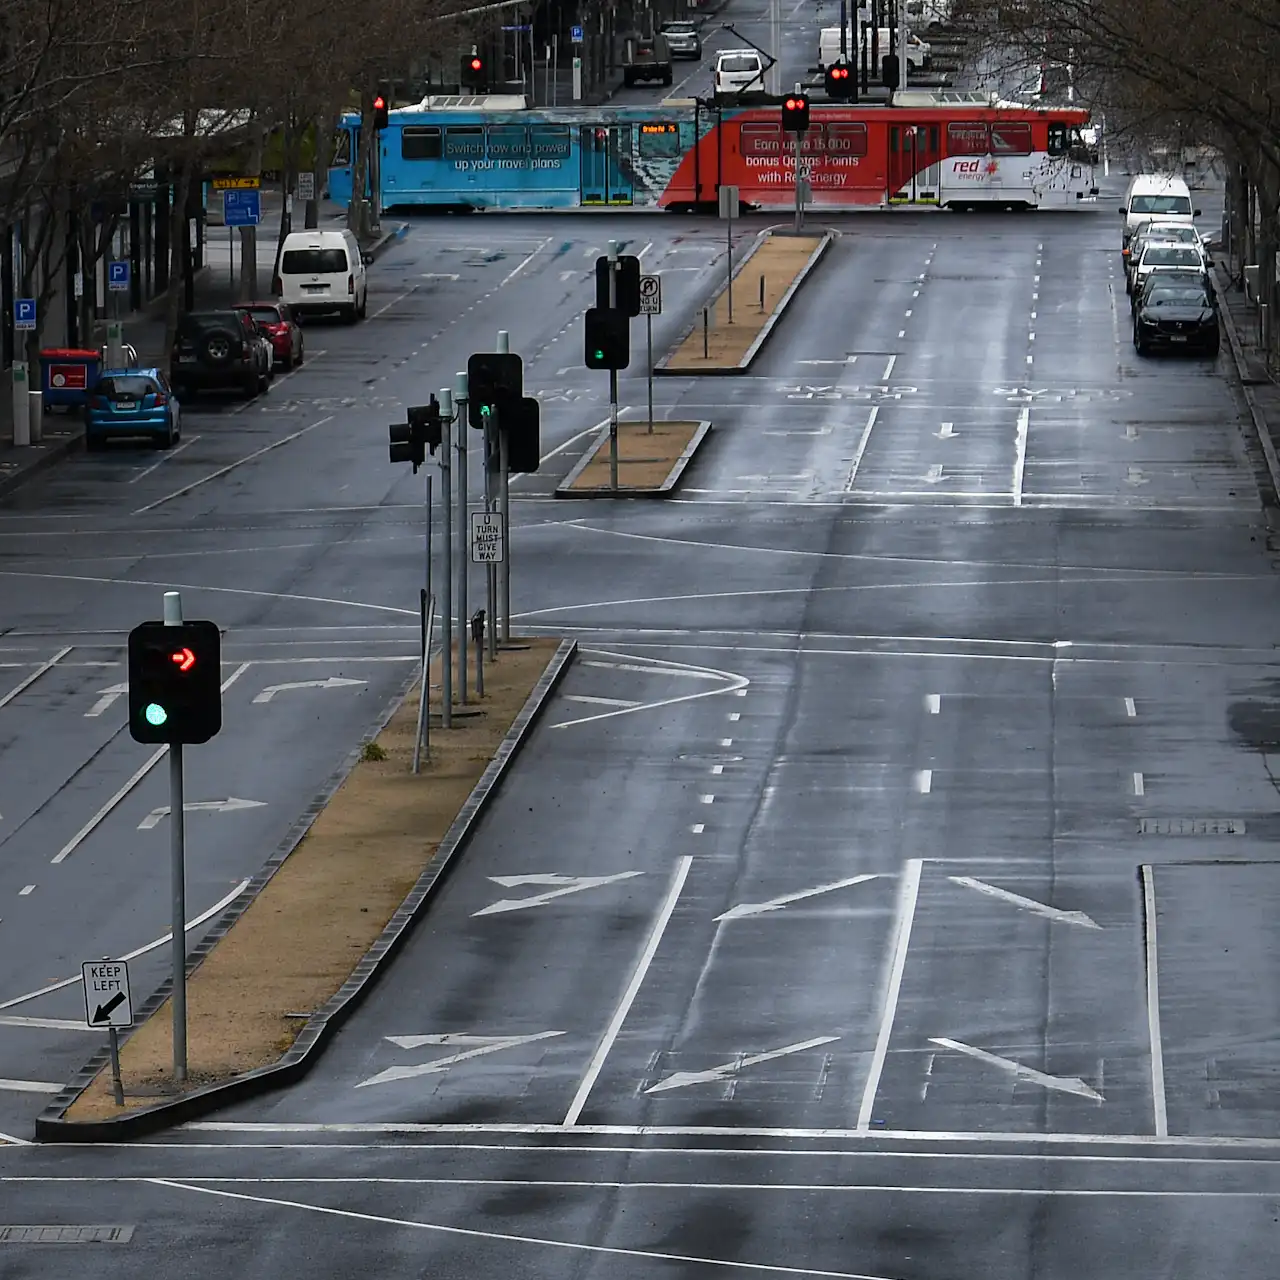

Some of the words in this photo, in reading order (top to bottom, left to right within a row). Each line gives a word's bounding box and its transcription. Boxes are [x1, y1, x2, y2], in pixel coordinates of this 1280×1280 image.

[447, 143, 484, 154] Switch
[486, 144, 508, 154] now
[511, 143, 531, 154] and
[535, 144, 568, 156] power
[754, 139, 780, 150] Earn
[454, 160, 469, 172] up
[471, 160, 495, 172] your
[498, 159, 528, 169] travel
[531, 158, 561, 171] plans
[746, 155, 780, 167] bonus
[824, 155, 860, 167] Points
[953, 159, 980, 173] red
[757, 171, 781, 183] with
[810, 171, 847, 185] Energy
[958, 173, 986, 183] energy
[113, 265, 124, 279] P
[20, 303, 31, 318] P
[483, 515, 491, 525] U
[476, 525, 499, 534] TURN
[476, 534, 498, 542] MUST
[478, 543, 497, 551] GIVE
[479, 552, 496, 560] WAY
[91, 966, 121, 978] KEEP
[93, 980, 121, 991] LEFT
